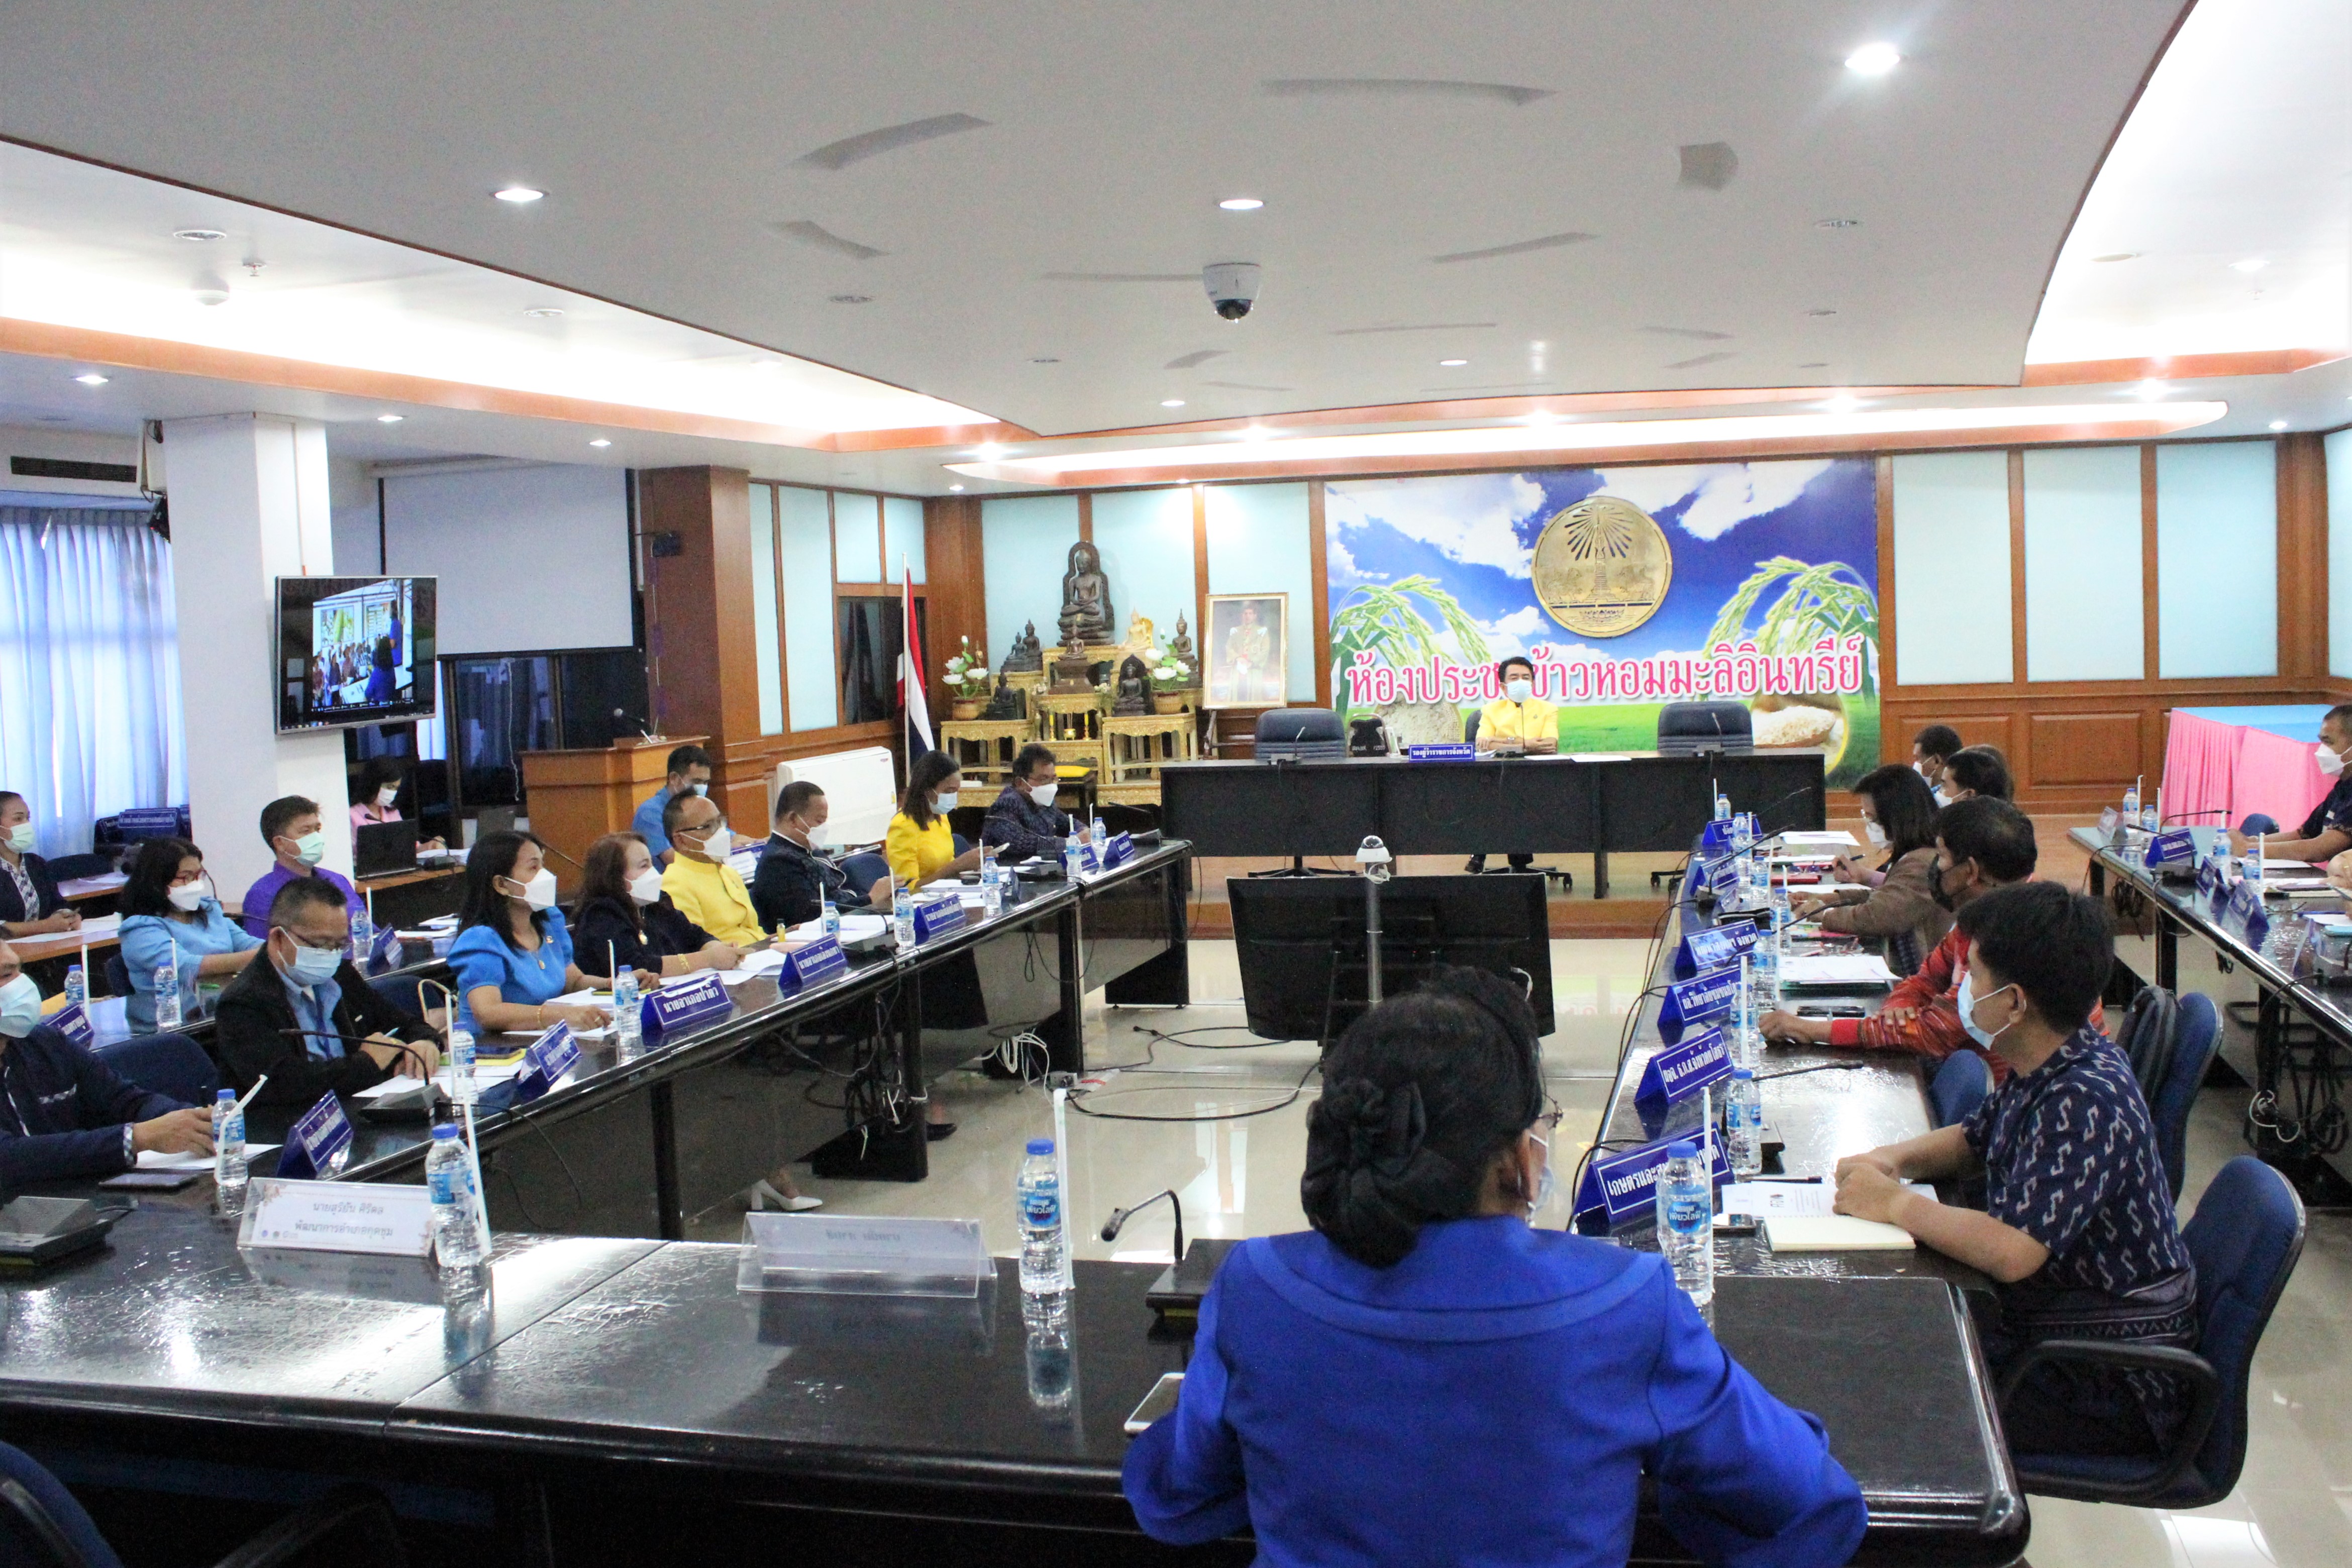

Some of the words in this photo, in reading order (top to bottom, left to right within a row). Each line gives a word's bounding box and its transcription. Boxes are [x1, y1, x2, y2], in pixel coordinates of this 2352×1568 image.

[1347, 635, 1861, 703] ห้องประชข้าวหอมมะลิอินทรีย์
